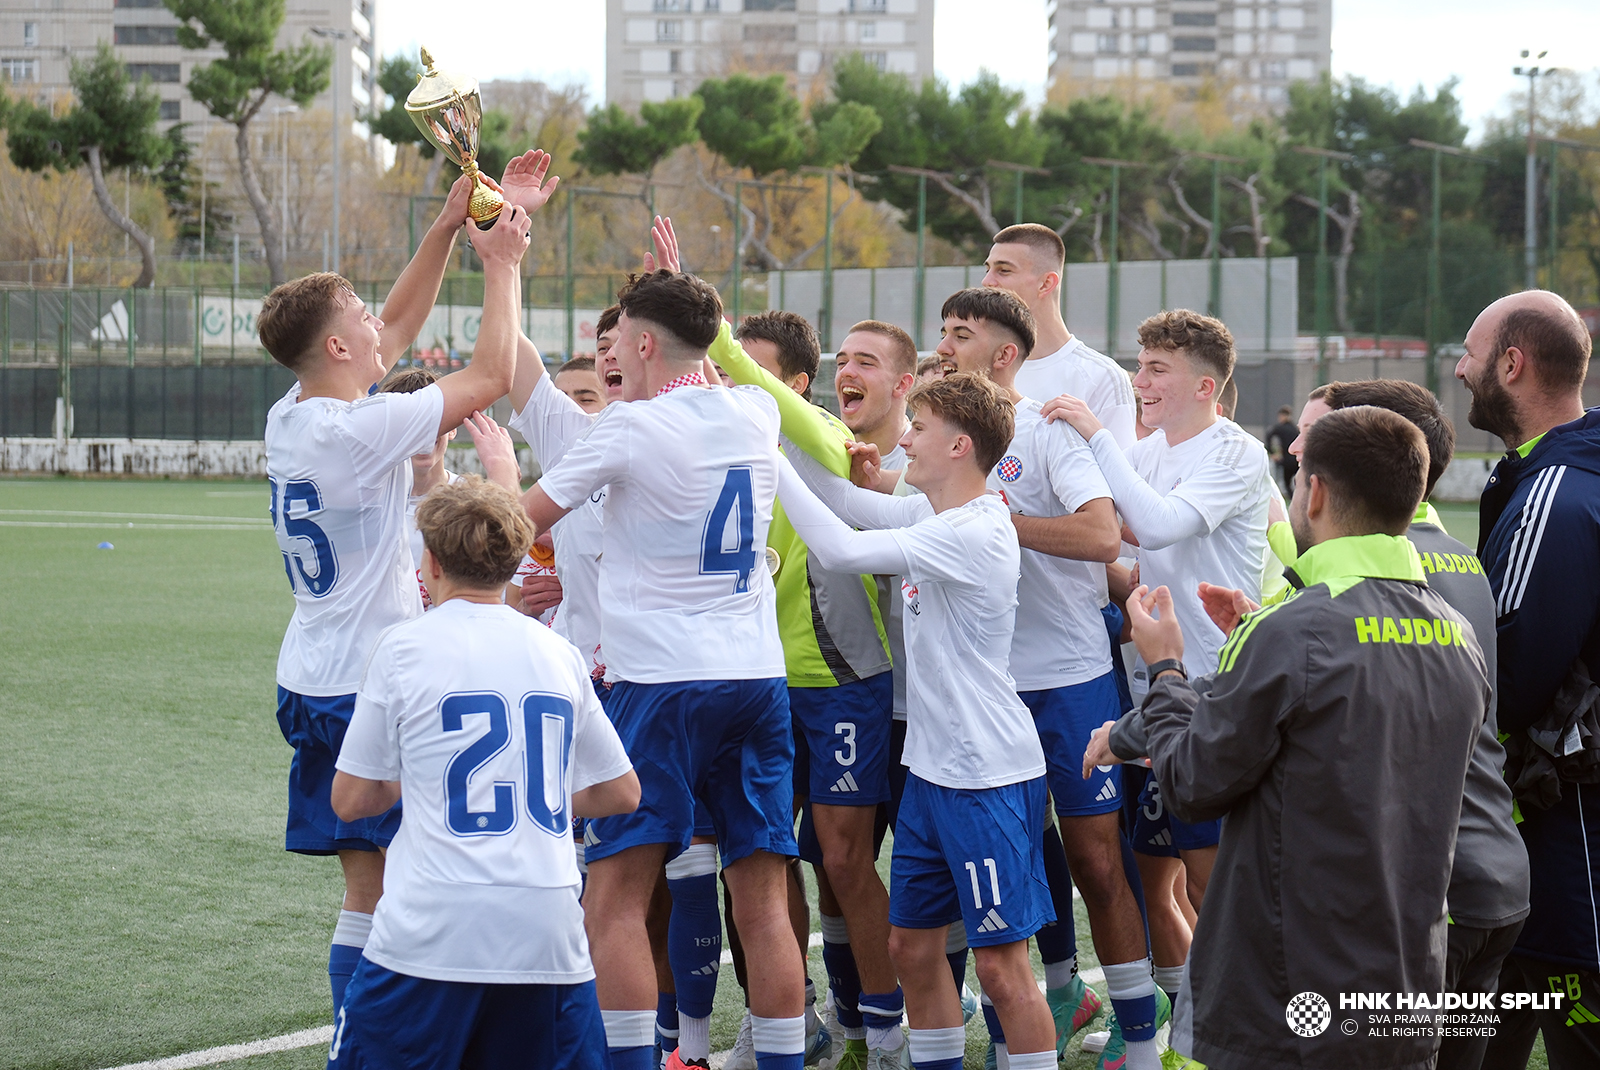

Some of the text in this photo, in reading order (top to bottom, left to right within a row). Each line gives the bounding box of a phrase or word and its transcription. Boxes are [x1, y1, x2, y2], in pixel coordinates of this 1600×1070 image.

[698, 464, 758, 595] 4
[1354, 616, 1468, 648] HAJDUK
[437, 689, 575, 839] 20
[835, 722, 856, 766] 3
[965, 858, 1001, 909] 11
[693, 935, 720, 947] 1911
